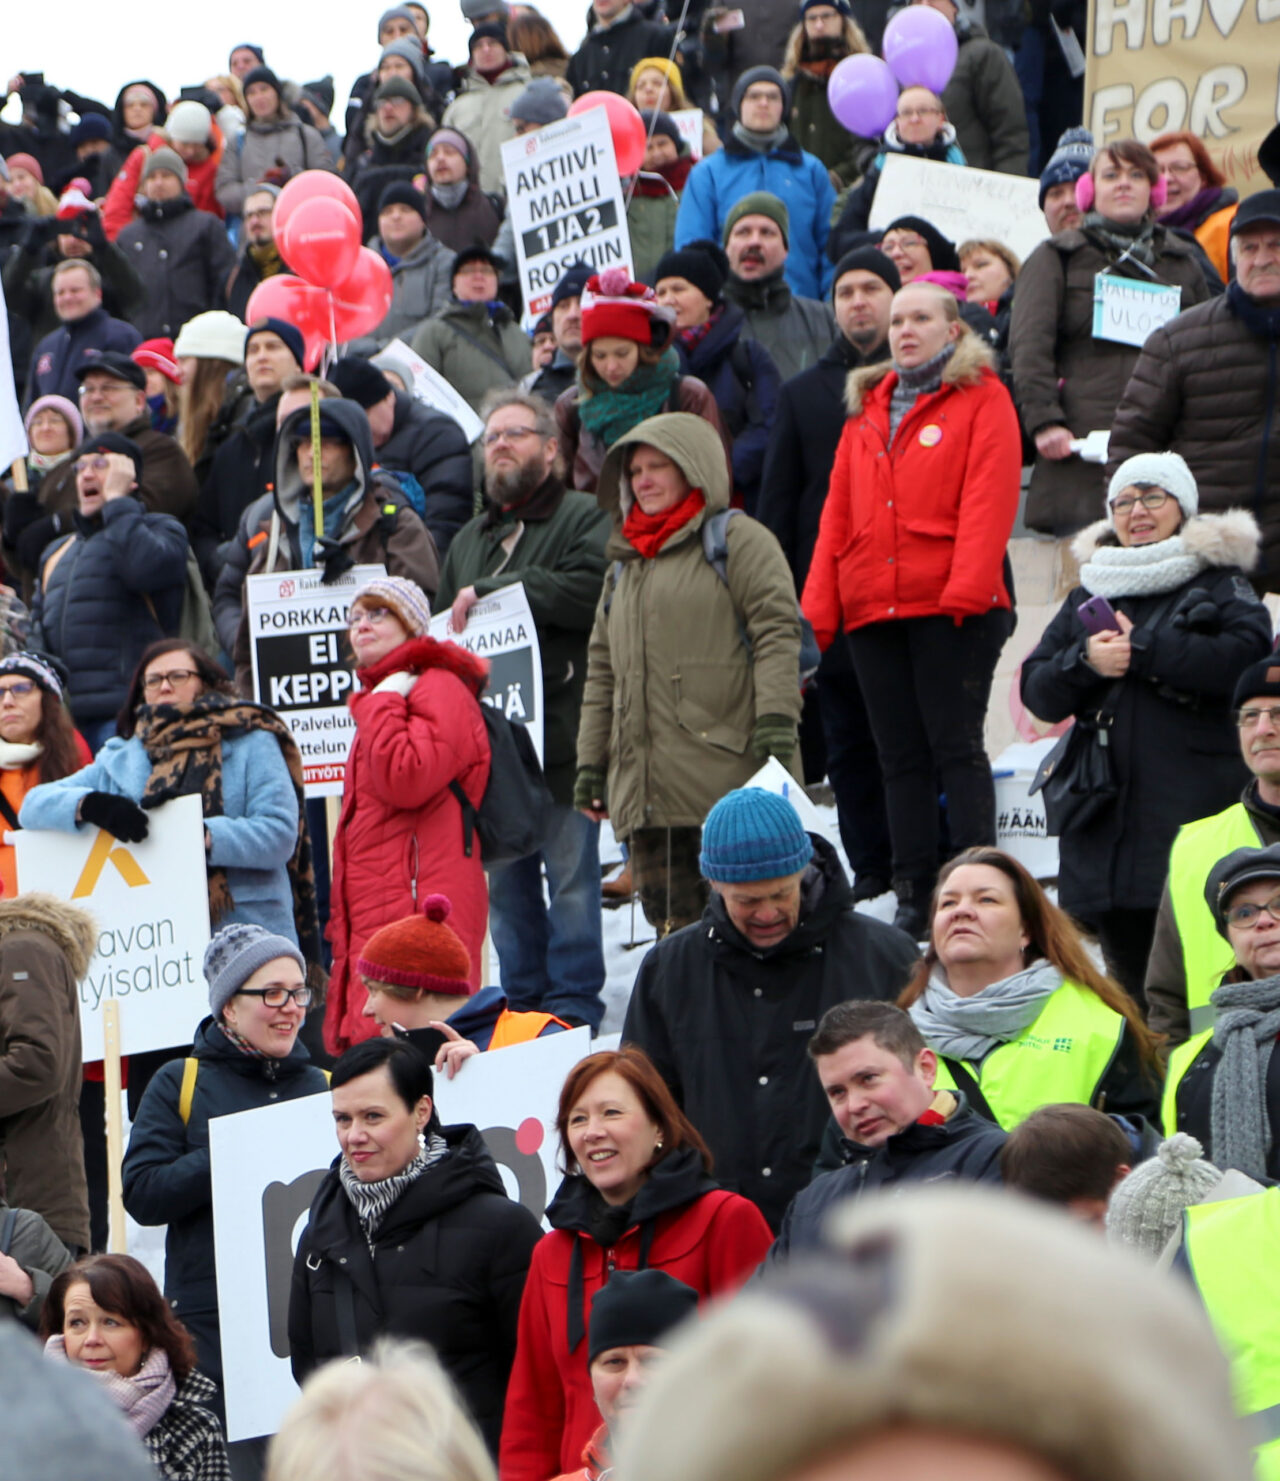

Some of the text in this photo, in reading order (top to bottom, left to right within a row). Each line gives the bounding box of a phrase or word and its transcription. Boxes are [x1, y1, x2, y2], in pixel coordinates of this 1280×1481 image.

[1090, 63, 1249, 149] FOR
[516, 142, 605, 195] AKTIIVI-
[529, 175, 601, 222] MALLI
[537, 207, 603, 250] 1 JA 2
[308, 632, 339, 666] EI
[270, 669, 363, 706] KEPPI
[300, 739, 347, 756] ttelun
[998, 806, 1046, 829] #ÄÄN
[95, 918, 175, 959] avan
[80, 950, 195, 1012] tyisalat
